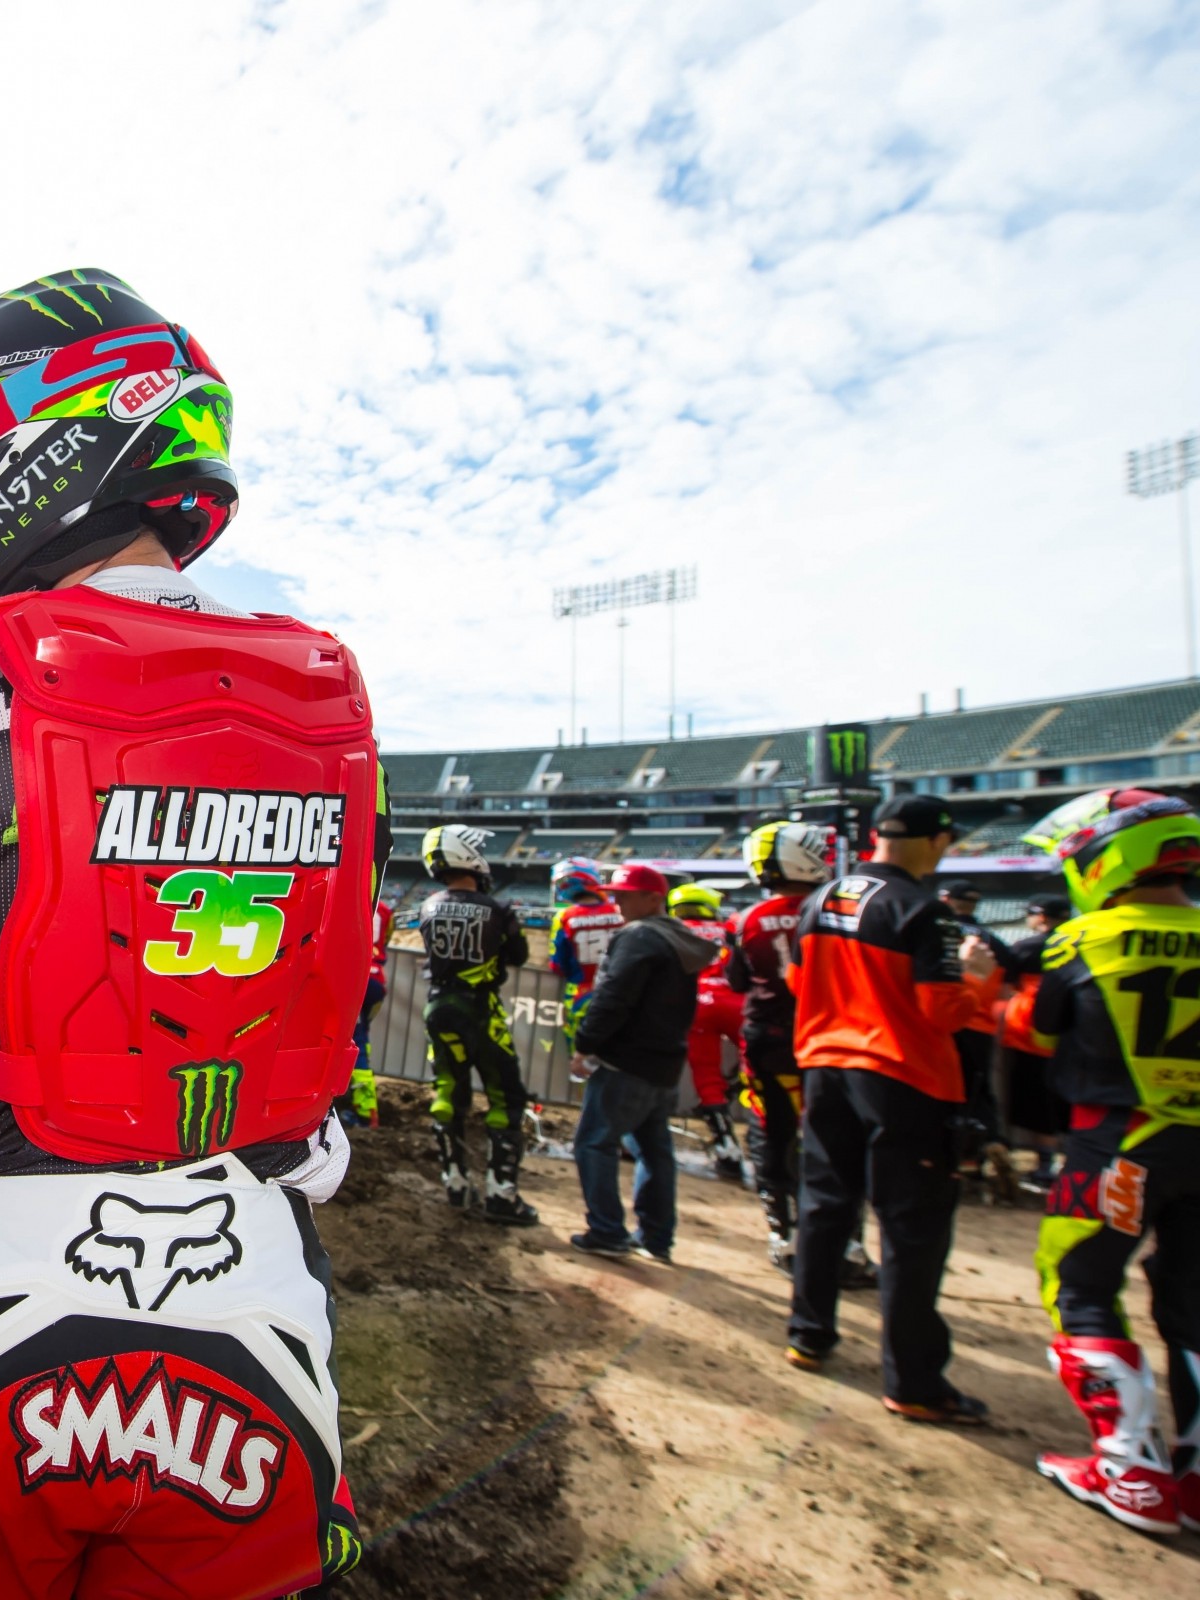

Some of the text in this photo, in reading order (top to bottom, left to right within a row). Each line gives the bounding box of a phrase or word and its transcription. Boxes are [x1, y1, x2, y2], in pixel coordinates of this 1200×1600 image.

[118, 369, 176, 414] BELL
[96, 789, 342, 864] ALLDREDGE
[143, 869, 296, 977] 35
[431, 917, 484, 963] 571
[1099, 1157, 1148, 1237] KTM
[22, 1379, 279, 1507] SMALLS
